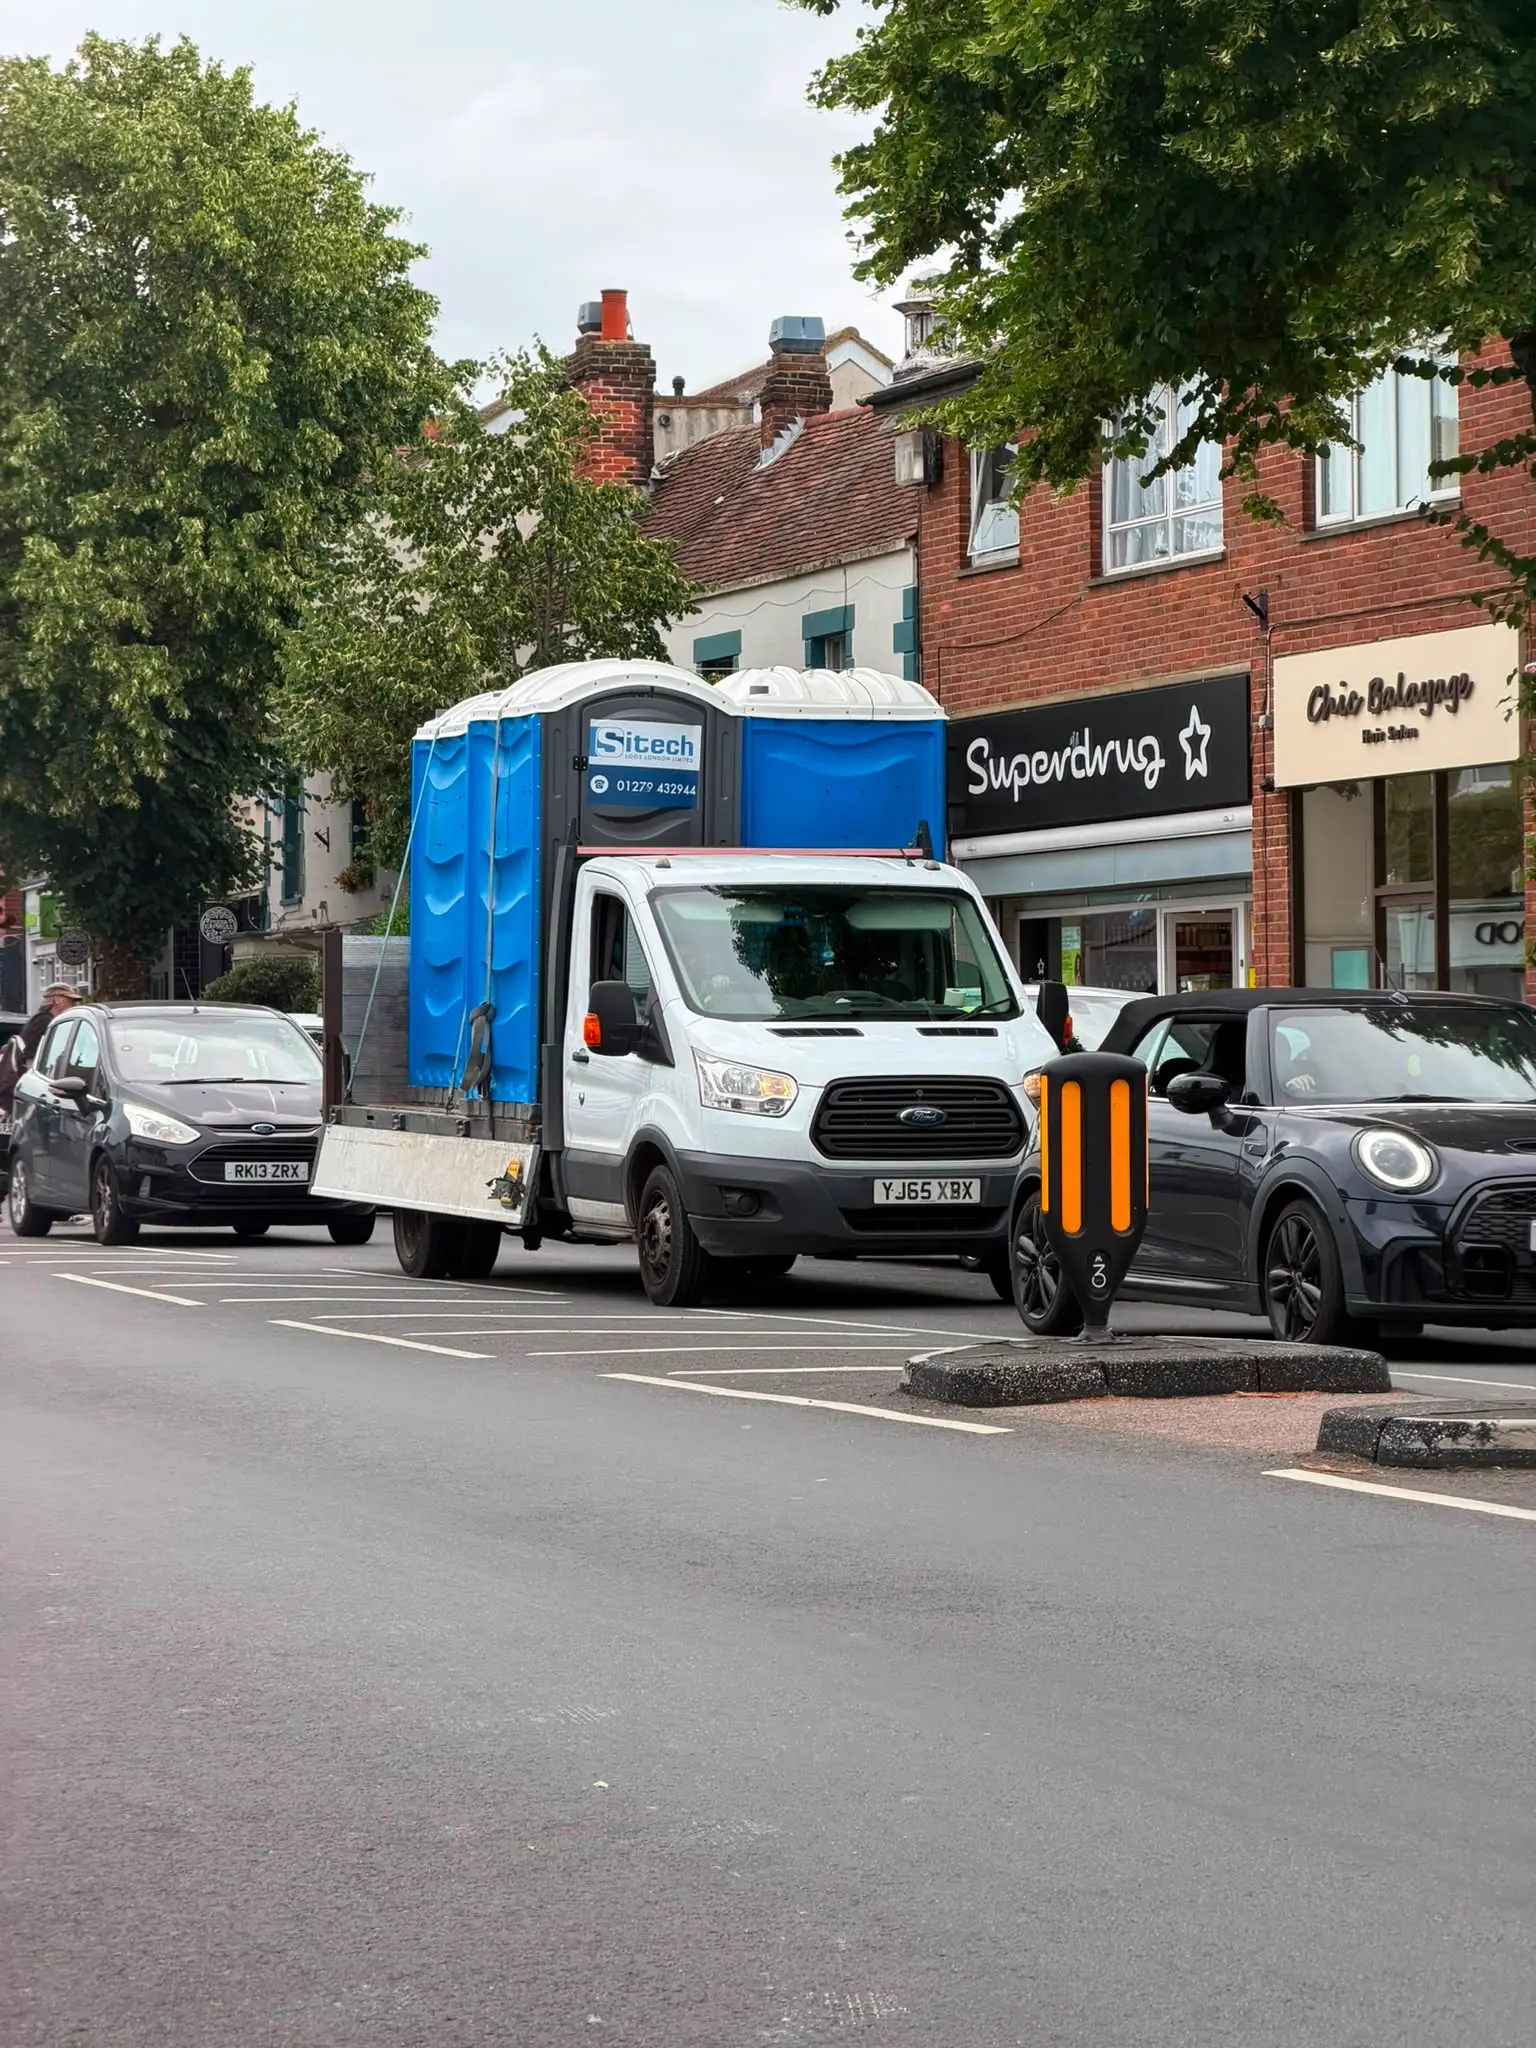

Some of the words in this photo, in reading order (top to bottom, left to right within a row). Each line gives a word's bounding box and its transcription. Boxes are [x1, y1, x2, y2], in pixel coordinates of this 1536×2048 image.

[1307, 681, 1364, 722] Chic
[1367, 672, 1474, 717] Balayage
[596, 727, 693, 757] Sitech
[1362, 728, 1386, 743] Hair
[966, 727, 1166, 802] Superdrug
[616, 780, 653, 793] 01279
[656, 782, 696, 796] 432944
[234, 1164, 267, 1178] RK13
[271, 1164, 299, 1178] ZRX
[882, 1181, 932, 1201] YJ65
[937, 1181, 973, 1201] XBX
